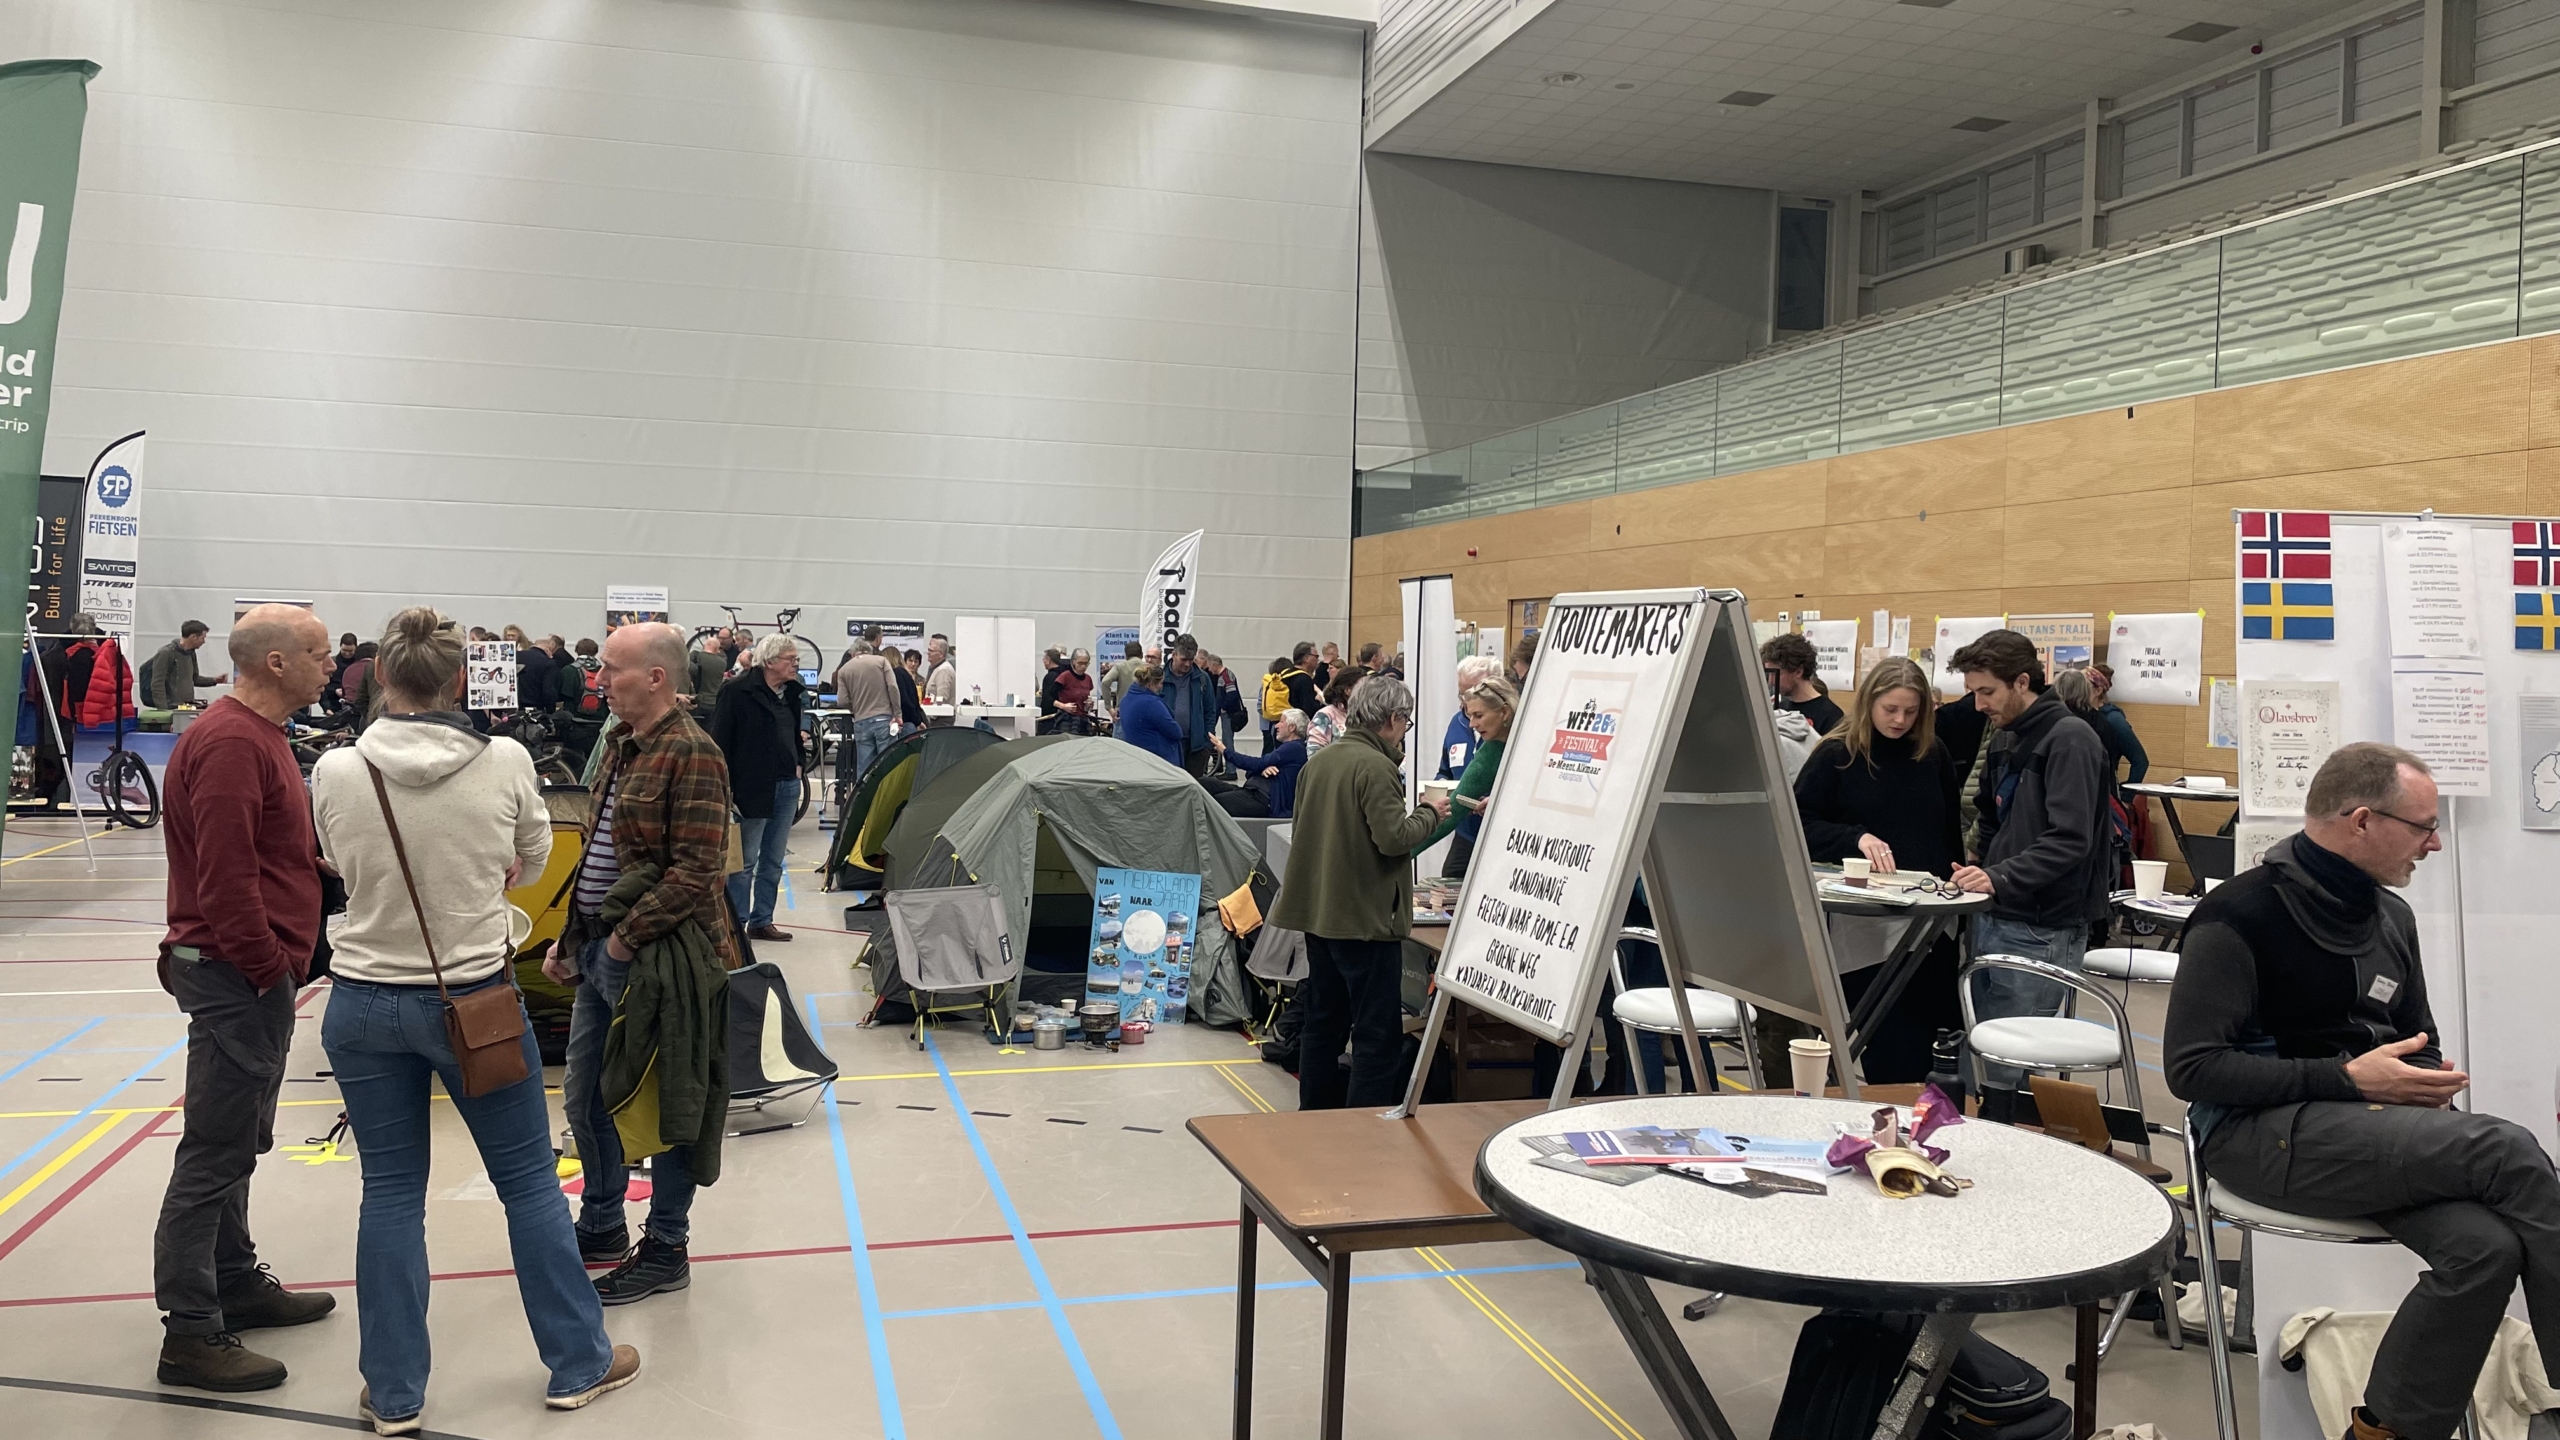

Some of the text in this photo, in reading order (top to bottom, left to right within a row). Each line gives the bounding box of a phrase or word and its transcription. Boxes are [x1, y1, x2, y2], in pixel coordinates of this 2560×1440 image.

[89, 521, 137, 537] FIETSEN
[45, 517, 66, 619] Built for Life
[87, 563, 134, 573] SANTOS
[83, 580, 134, 589] STEVENS
[1551, 604, 1692, 659] ROUTEMAKERS
[2059, 624, 2091, 634] TRAIL
[2259, 706, 2318, 724] Olavsbrev
[1562, 735, 1599, 753] FESTIVAL
[1548, 758, 1557, 768] De
[1576, 763, 1601, 775] Alkmaar
[1506, 828, 1595, 872] BALKAN KUSTROUTE
[1098, 870, 1195, 893] VAN NEDERLAND
[1130, 891, 1196, 911] NAAR JAPAN
[1506, 907, 1532, 935] NAAR
[1530, 914, 1561, 946] ROME
[1485, 938, 1541, 980] GROENE WEG
